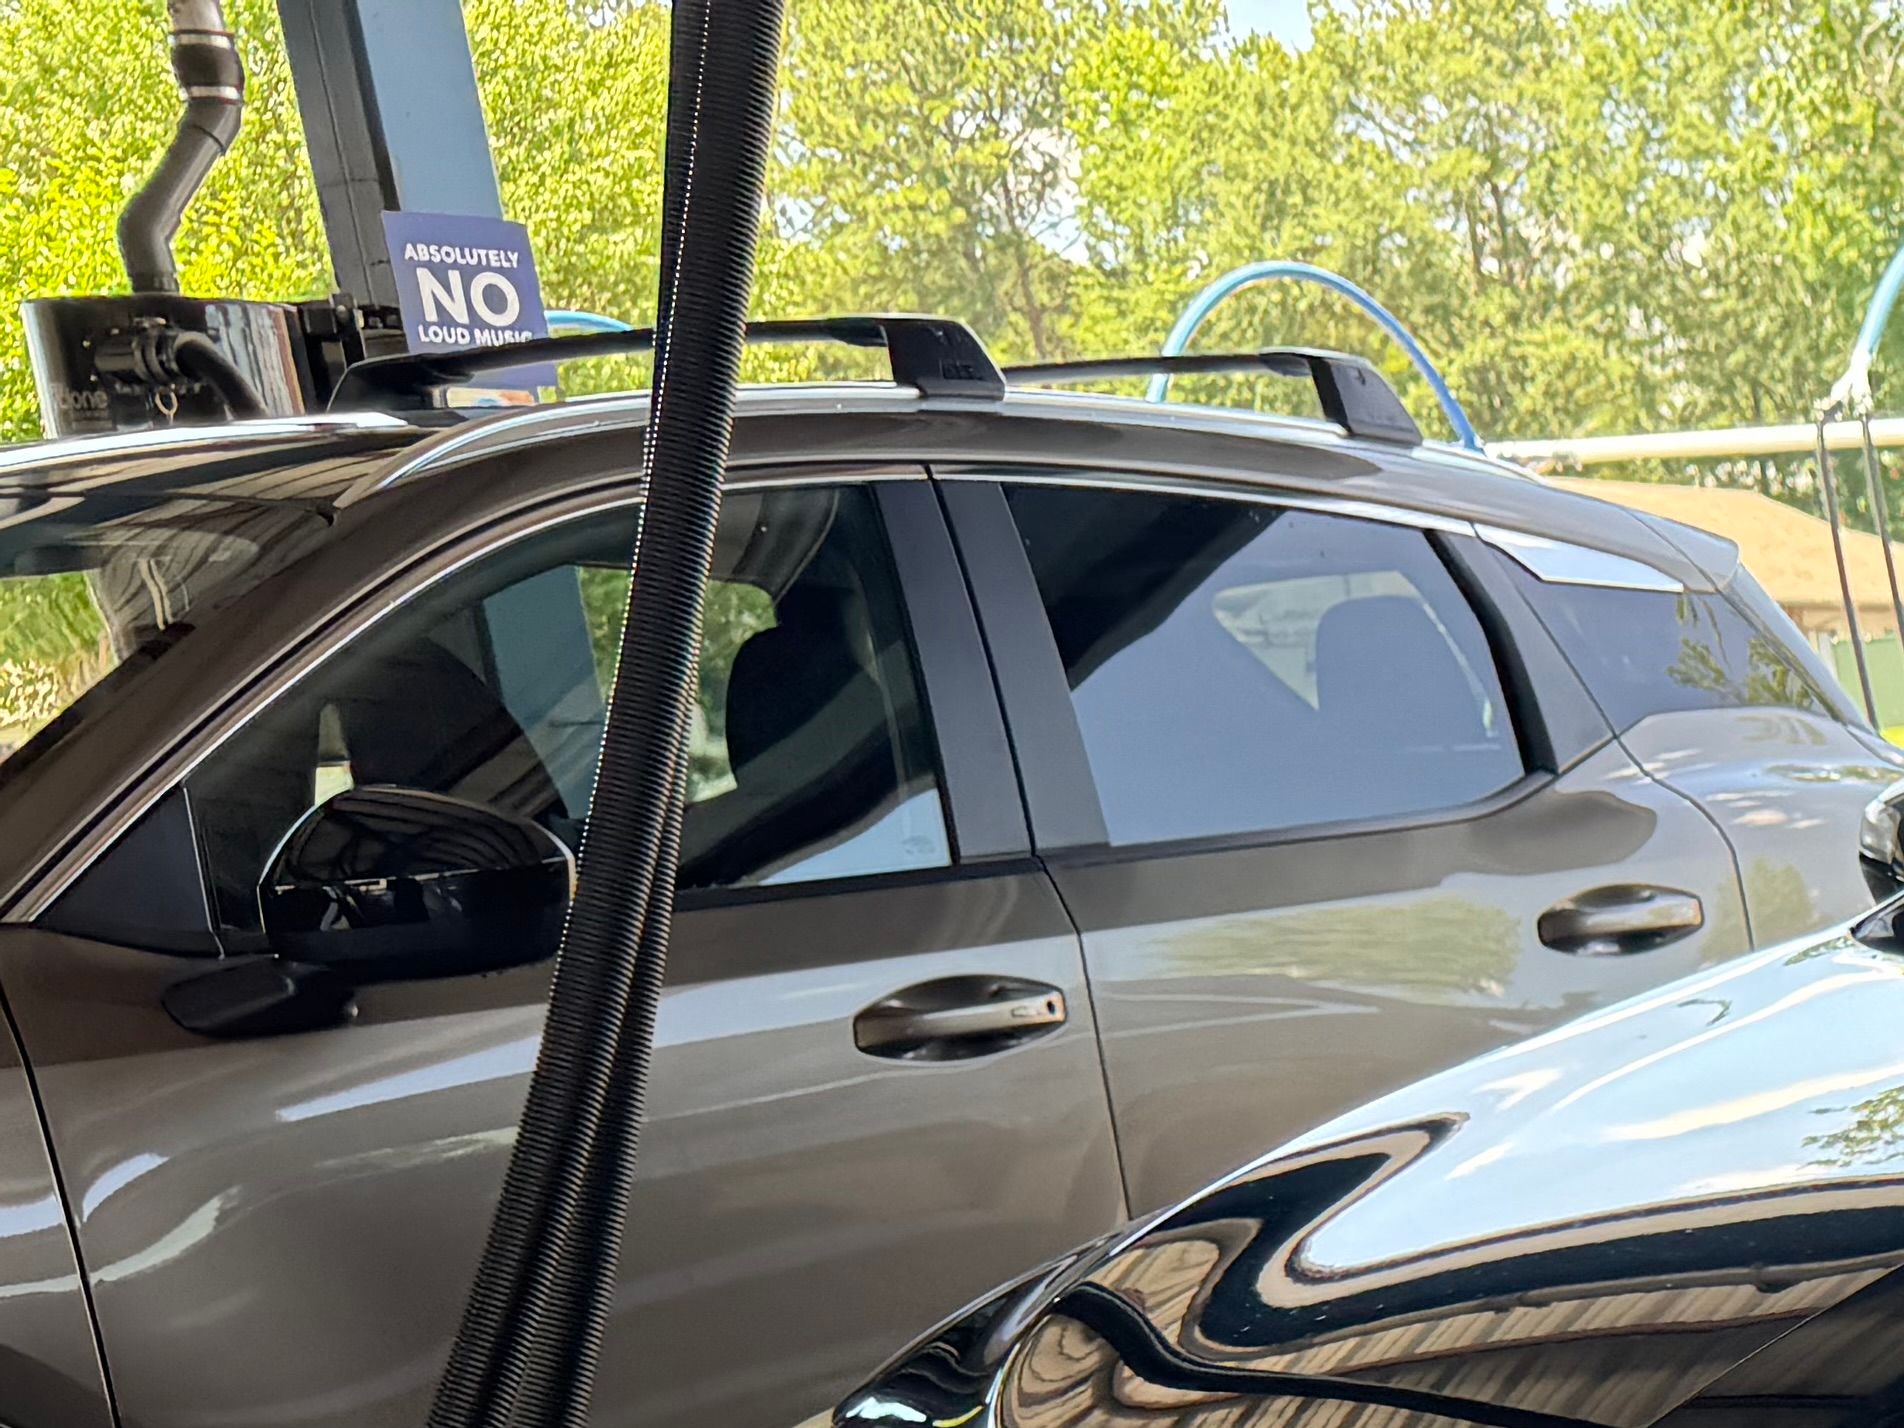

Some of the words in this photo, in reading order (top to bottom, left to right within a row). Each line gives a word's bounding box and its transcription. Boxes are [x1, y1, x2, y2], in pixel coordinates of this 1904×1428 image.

[404, 243, 520, 269] ABSOLUTELY
[415, 266, 521, 328] NO
[417, 323, 471, 345] LOUD
